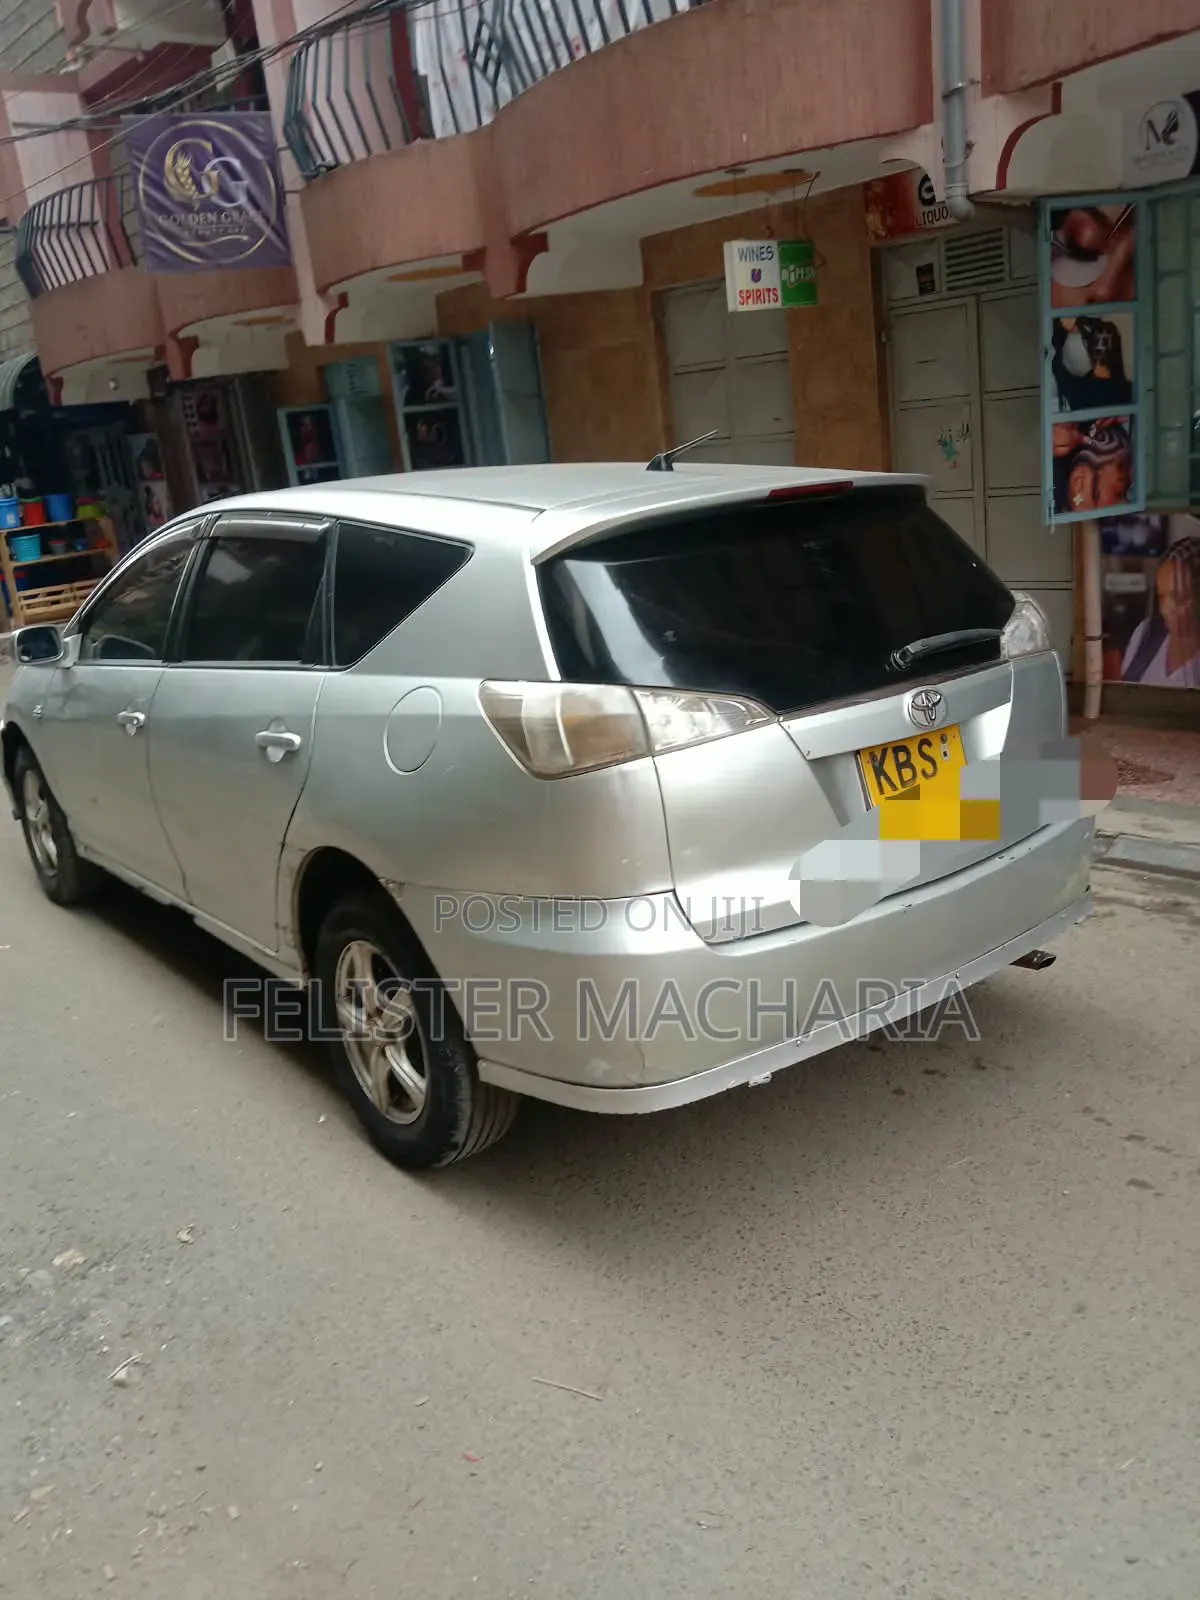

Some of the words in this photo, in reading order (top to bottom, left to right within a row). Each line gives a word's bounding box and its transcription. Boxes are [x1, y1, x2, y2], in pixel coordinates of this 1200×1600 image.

[915, 206, 952, 227] LIQUO
[737, 245, 774, 262] WINES
[738, 287, 779, 306] SPIRITS
[870, 738, 938, 796] KBS
